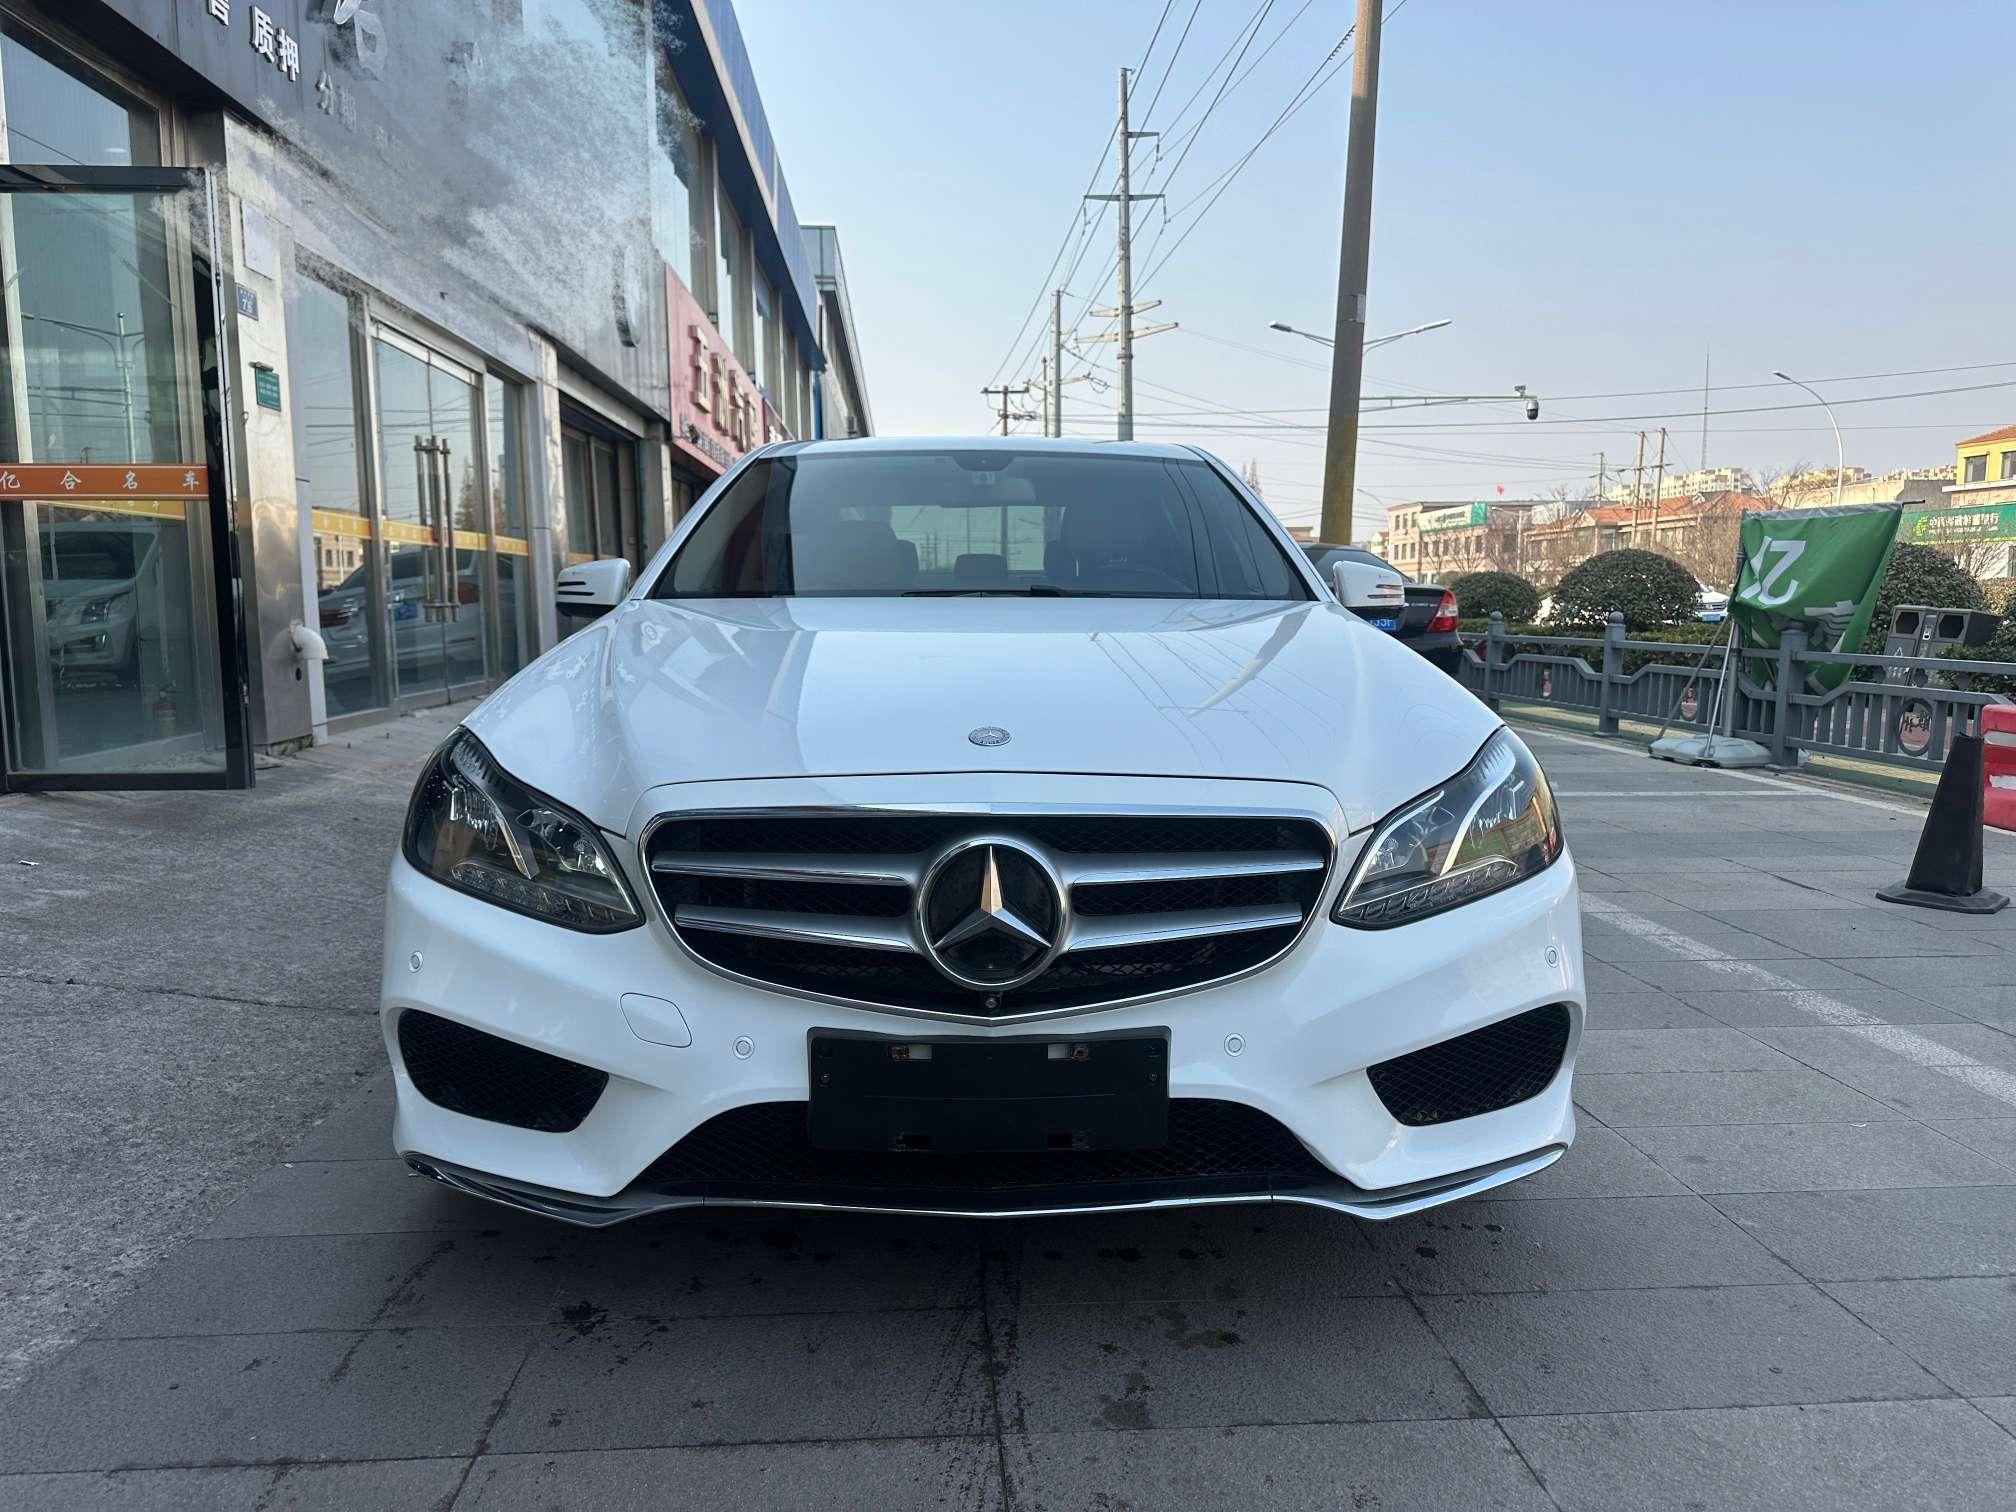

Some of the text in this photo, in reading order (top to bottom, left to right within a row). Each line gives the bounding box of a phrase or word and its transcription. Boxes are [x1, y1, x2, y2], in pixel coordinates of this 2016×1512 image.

[250, 4, 300, 82] 质押
[0, 470, 200, 491] 亿合名车
